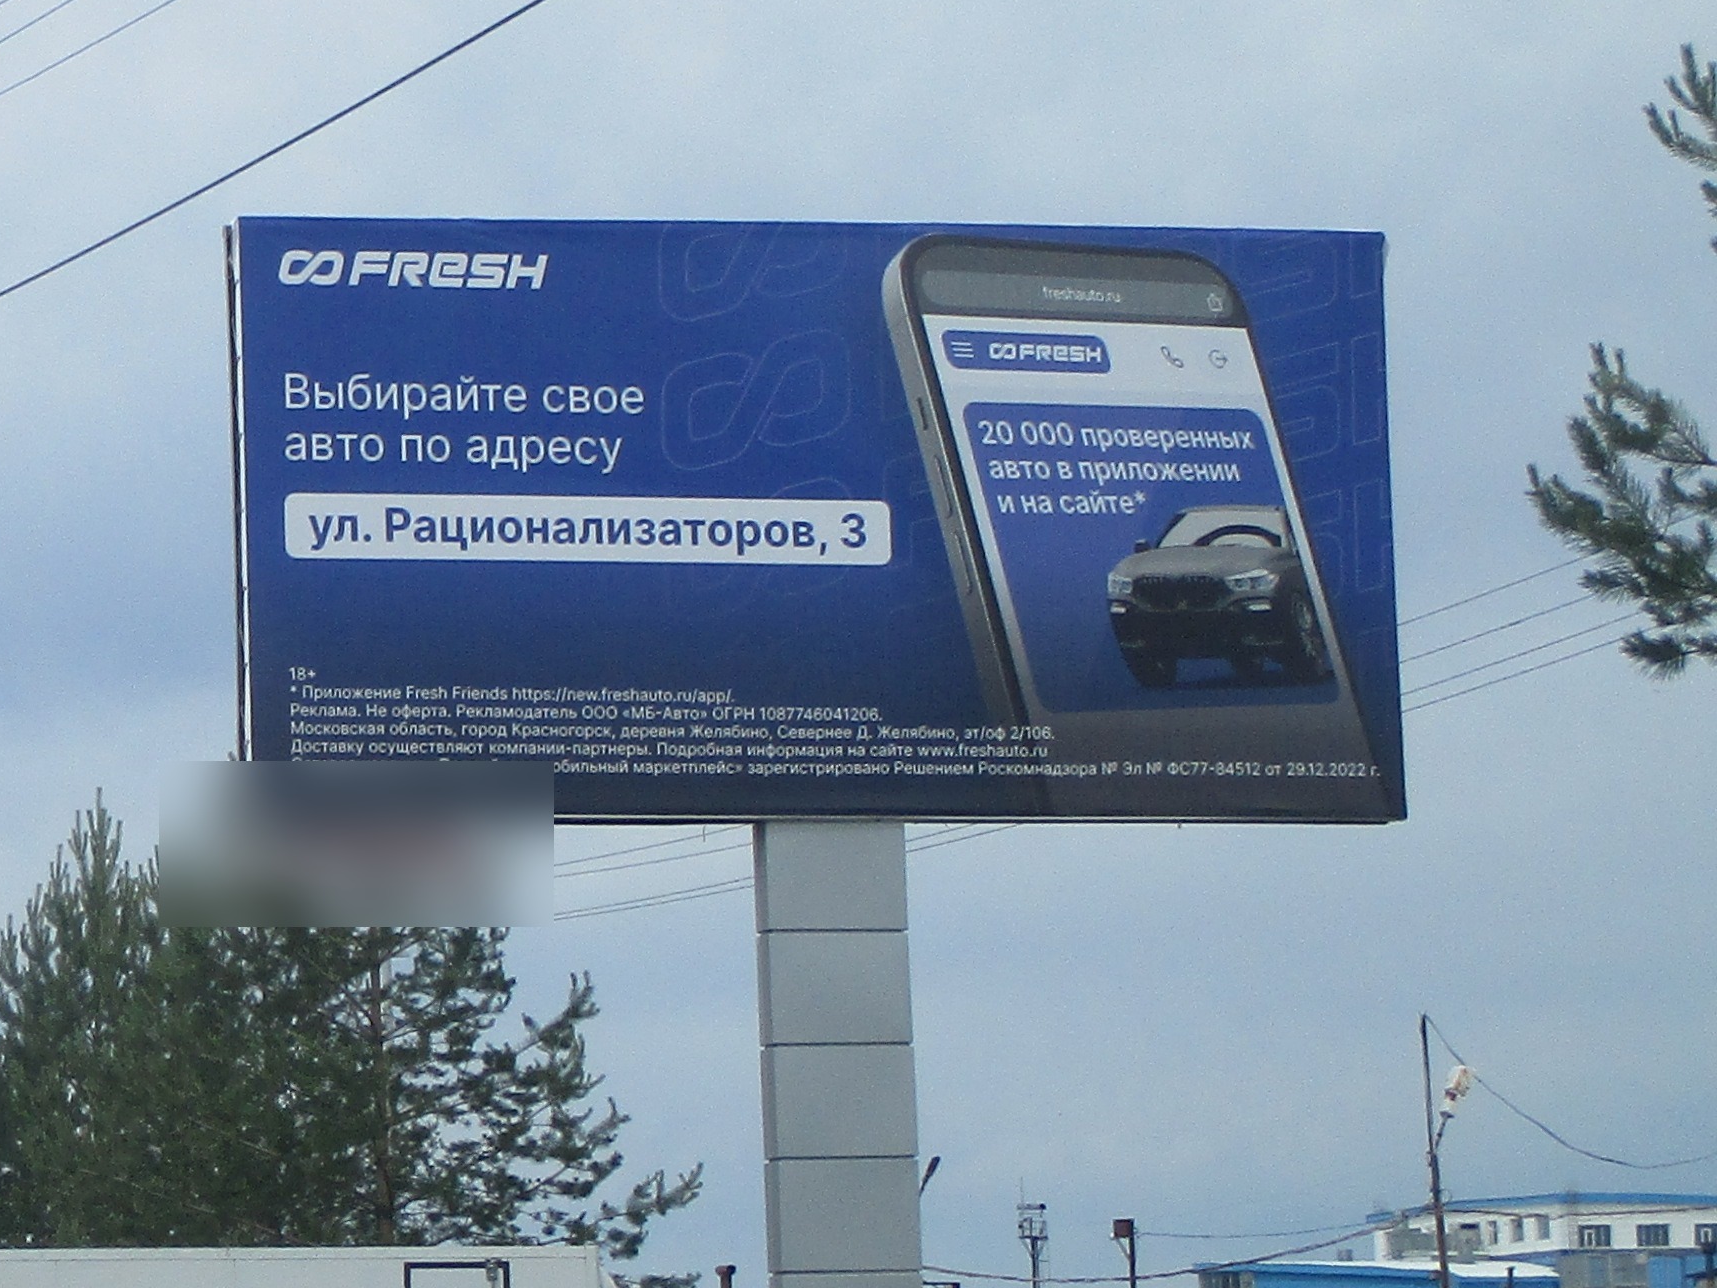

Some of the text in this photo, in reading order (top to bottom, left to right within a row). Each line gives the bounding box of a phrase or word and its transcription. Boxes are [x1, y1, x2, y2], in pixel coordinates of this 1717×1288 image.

[348, 250, 549, 290] FRESH
[1042, 285, 1122, 305] freshauto.ru
[1019, 343, 1102, 363] FRESH
[284, 372, 645, 417] Выбирайте свое
[978, 421, 1256, 452] 20 000 проверенных
[284, 427, 623, 474] авто по адресу
[989, 460, 1241, 486] авто в приложении
[997, 494, 1015, 514] и
[1021, 495, 1055, 515] на
[309, 508, 867, 555] ул. Рационализаторов, 3
[289, 667, 316, 681] 18+
[302, 685, 735, 705] Приложение Fresh Friends https://new.freshauto.ru/app/.
[290, 703, 884, 722] Реклама. Не оферта. Рекламодатель ООО «МБ-Авто» ОГРН 1087746041206.
[290, 721, 1055, 742] Московская область, город Красногорск, деревня Желябино, Севернее Д. Желябино, эт/оф 2/106.
[291, 739, 1048, 760] Доставку осуществляют компании-партнеры. Подробная информация на сайте www.freshauto.ru
[554, 759, 629, 775] обильный
[748, 762, 890, 778] зарегистрировано
[894, 762, 974, 775] Решением
[978, 762, 1097, 778] Роскомнадзора
[1265, 764, 1281, 776] от
